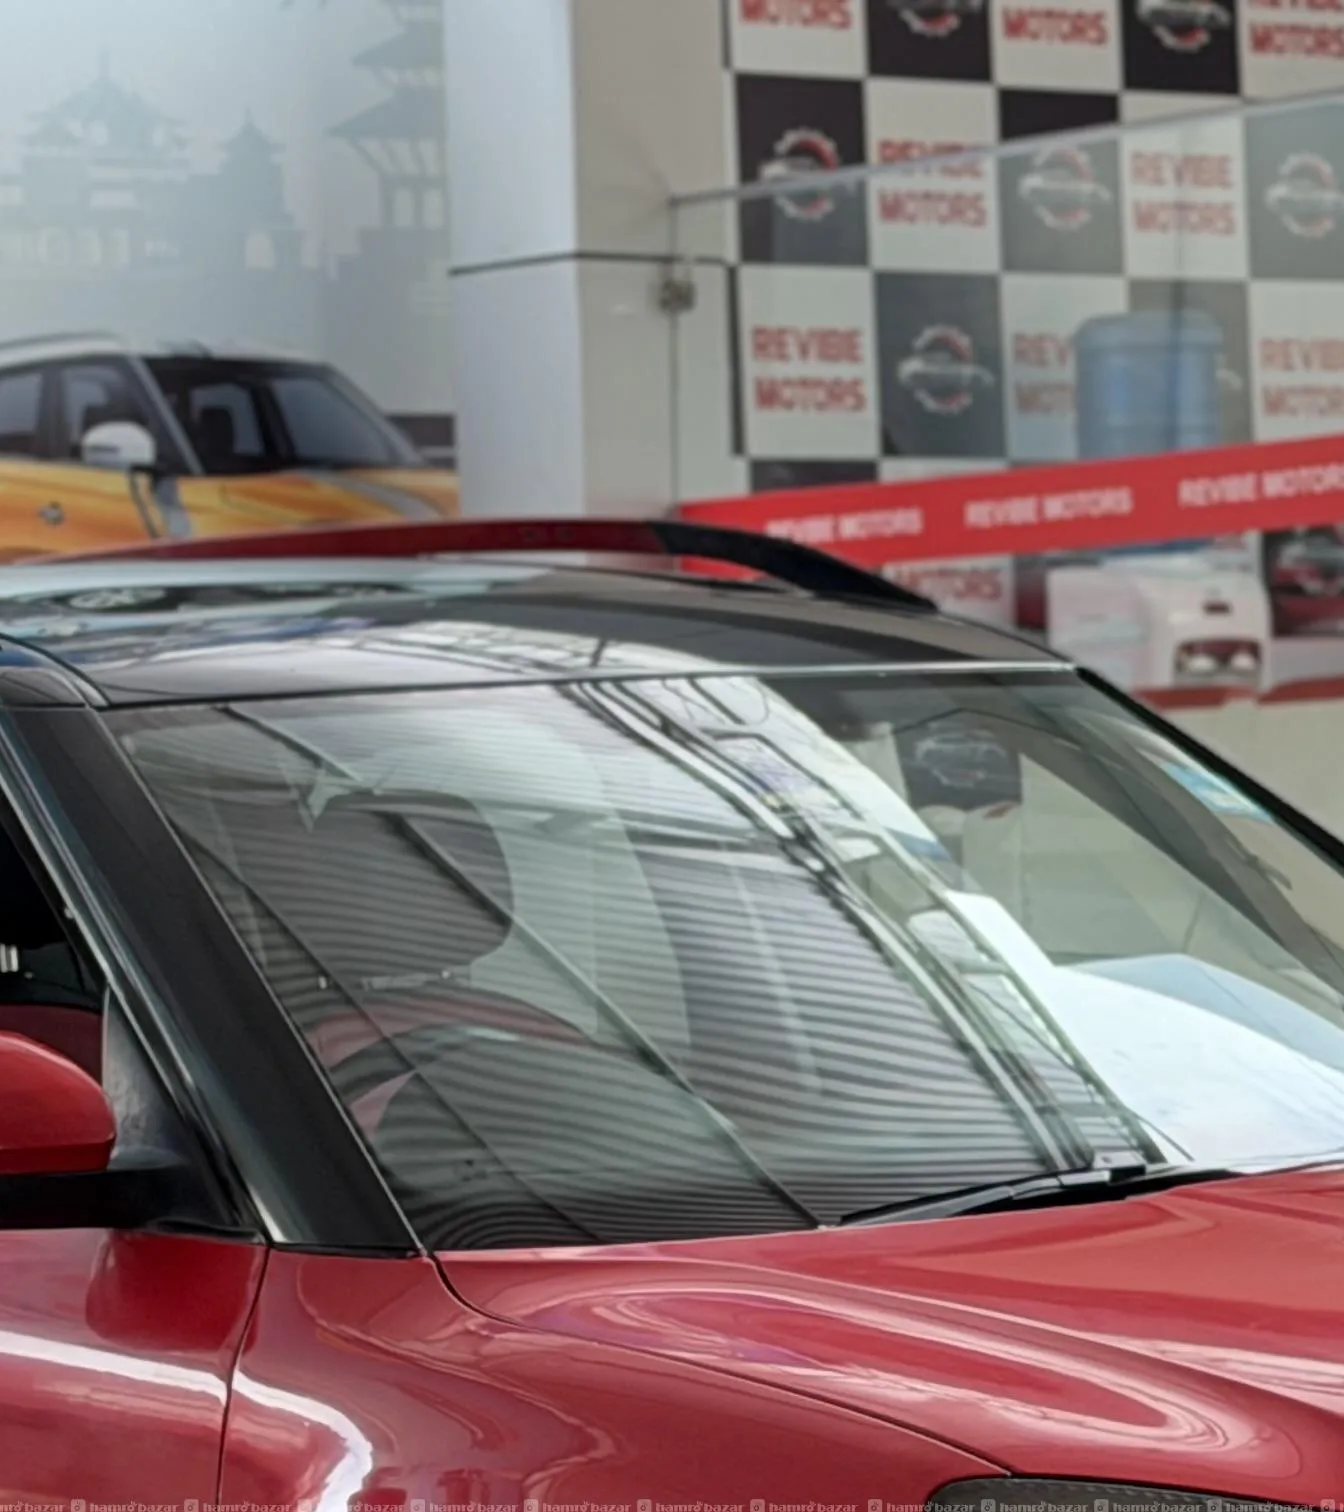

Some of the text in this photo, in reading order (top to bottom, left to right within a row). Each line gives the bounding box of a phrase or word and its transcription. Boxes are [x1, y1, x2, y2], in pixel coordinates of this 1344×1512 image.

[740, 0, 852, 30] MOTORS
[1002, 8, 1108, 45] MOTORS
[1131, 153, 1232, 190] REVIBE
[879, 190, 987, 228] MOTORS
[1133, 201, 1237, 235] MOTORS
[753, 326, 863, 363] REVIBE
[1013, 332, 1070, 369] REV
[754, 377, 867, 413] MOTORS
[839, 508, 923, 539] MOTORS
[964, 497, 1039, 528] REVIBE
[1042, 487, 1133, 520] MOTORS
[1178, 473, 1257, 508] REVIBE
